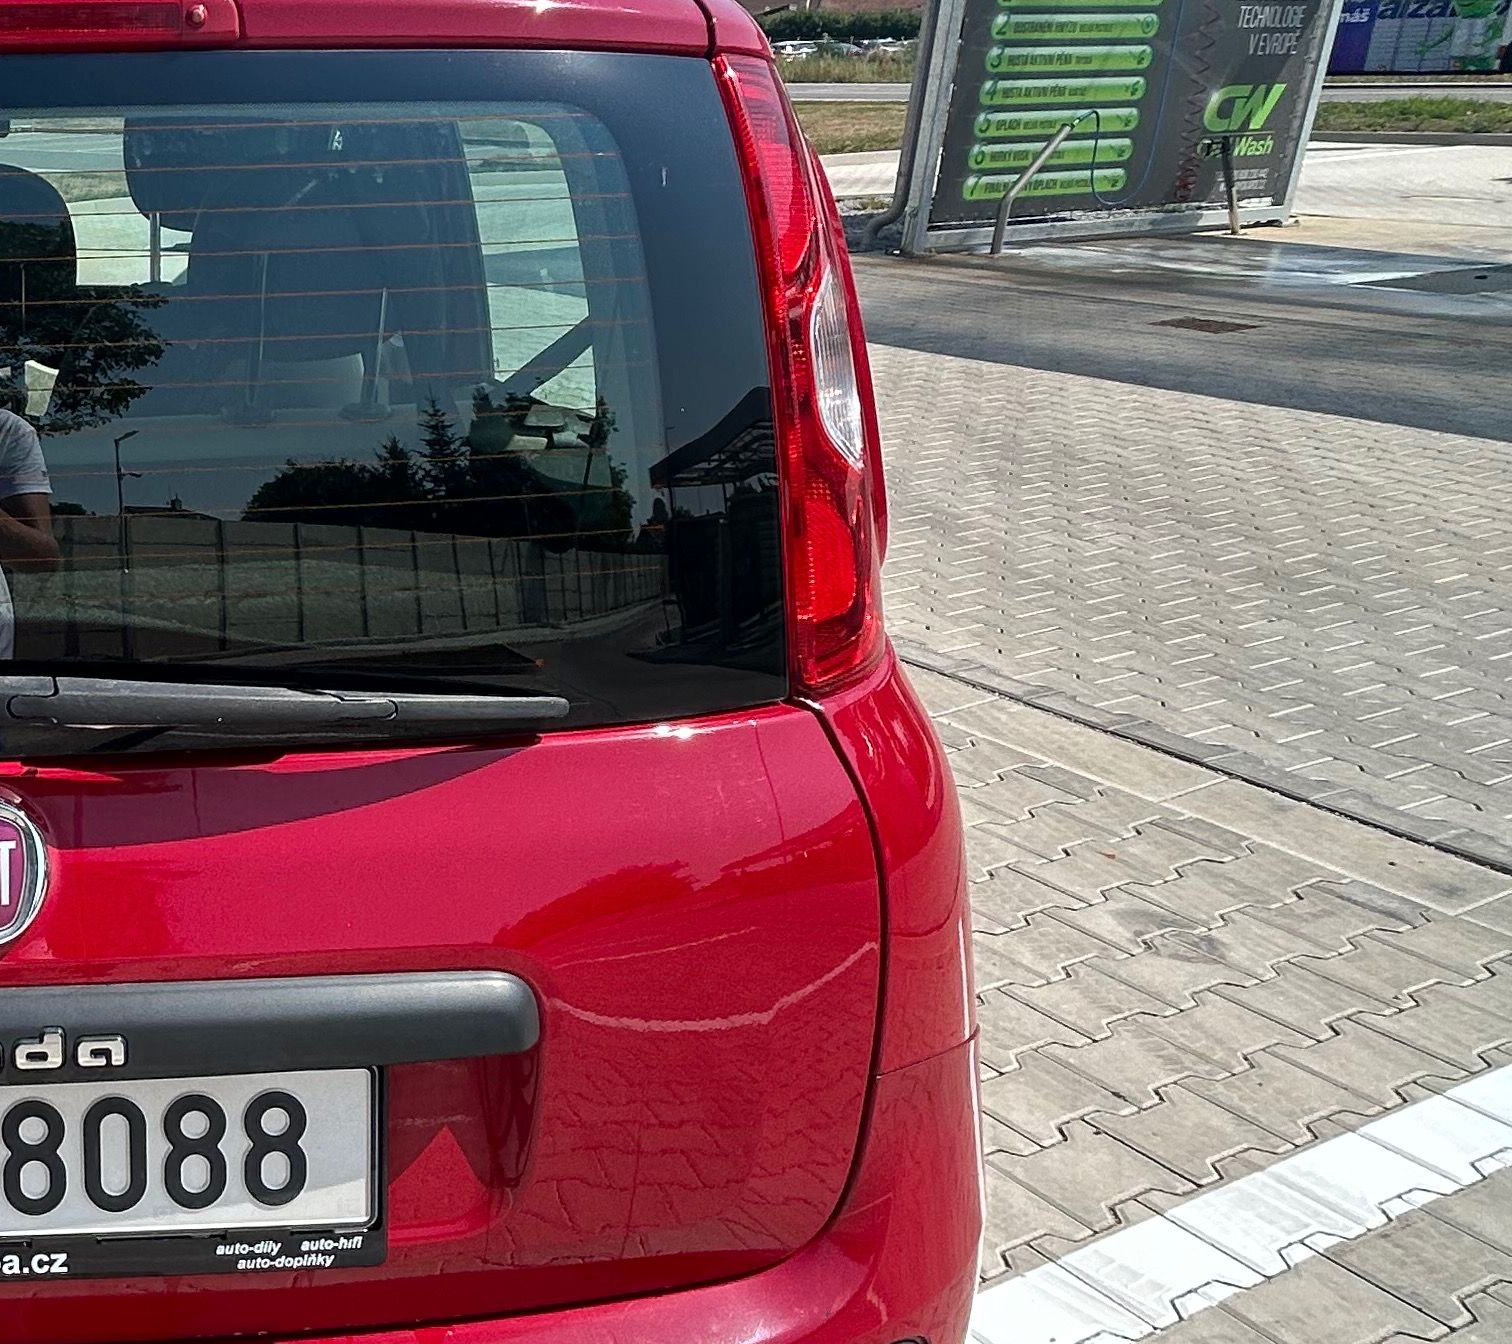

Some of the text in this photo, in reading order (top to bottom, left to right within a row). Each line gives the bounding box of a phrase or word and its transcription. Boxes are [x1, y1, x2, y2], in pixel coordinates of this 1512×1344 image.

[1238, 5, 1307, 29] TECHNOLOGIE
[1259, 30, 1301, 56] EVROPĚ
[1230, 135, 1274, 157] Wash
[1, 1091, 307, 1216] 8088
